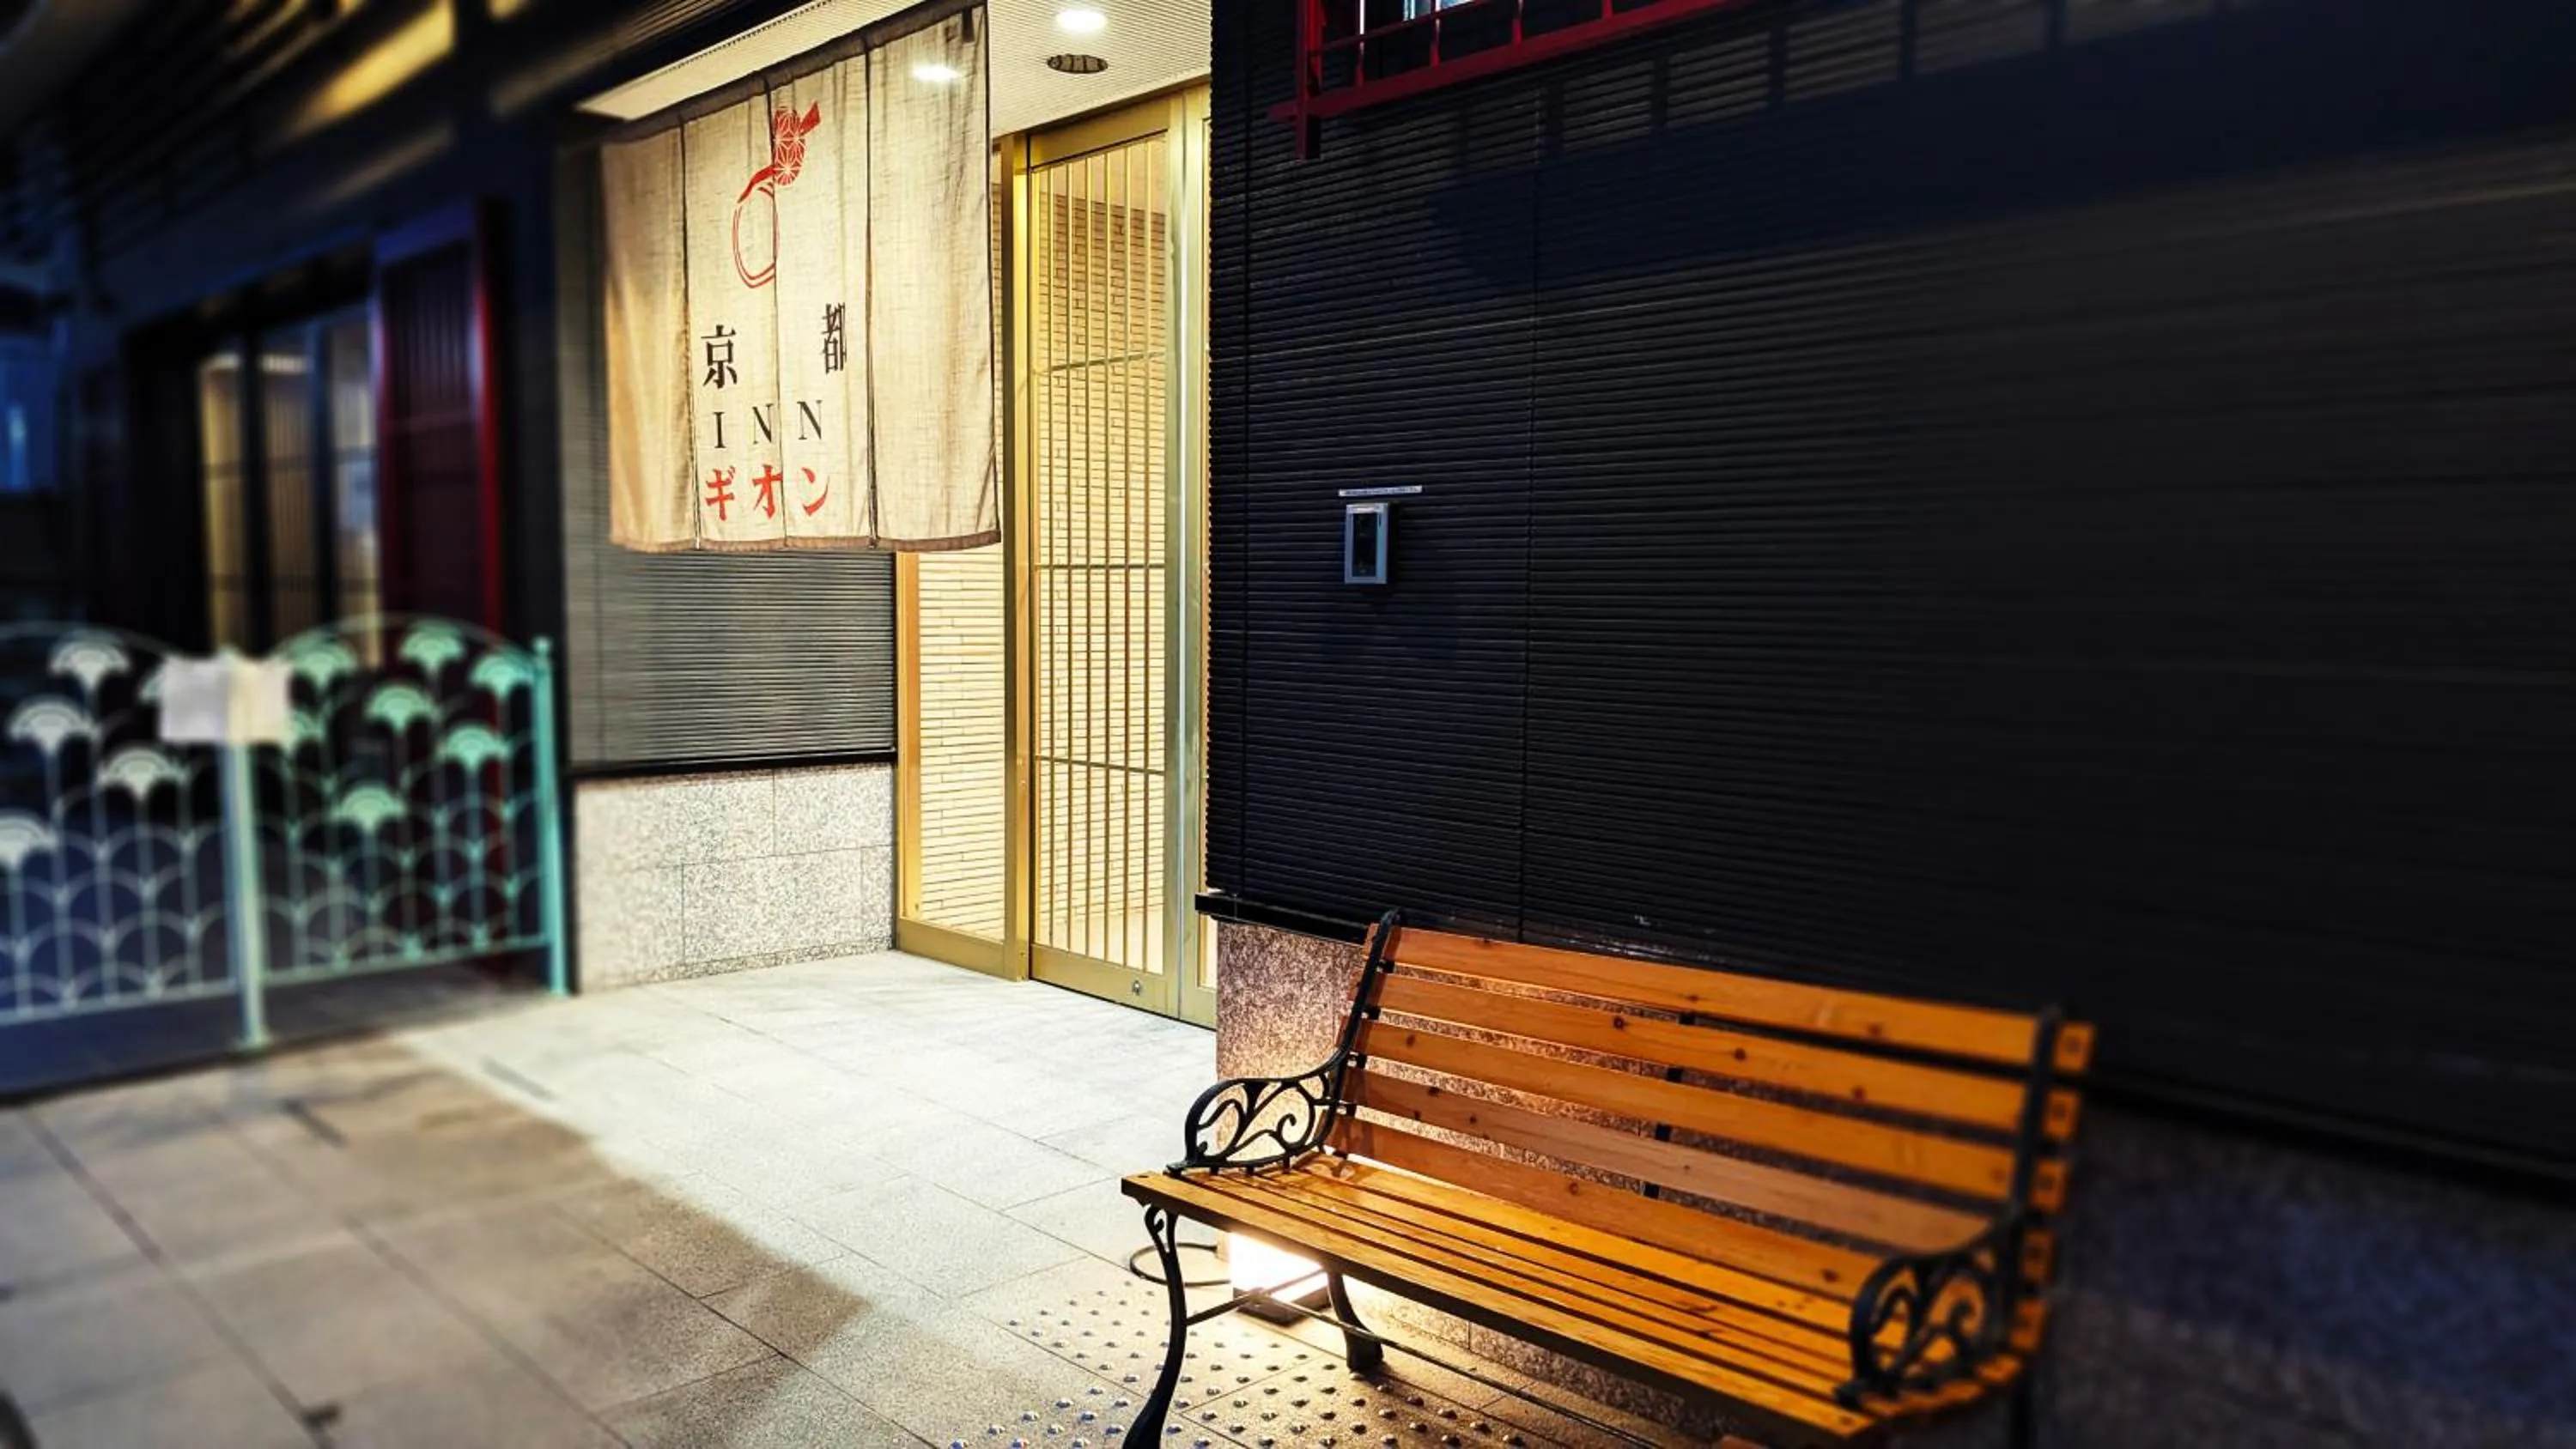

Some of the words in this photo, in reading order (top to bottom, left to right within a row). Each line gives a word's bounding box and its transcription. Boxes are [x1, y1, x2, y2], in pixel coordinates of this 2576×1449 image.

[701, 302, 847, 389] 京都
[713, 399, 823, 450] INN
[704, 464, 829, 521] ギオン
